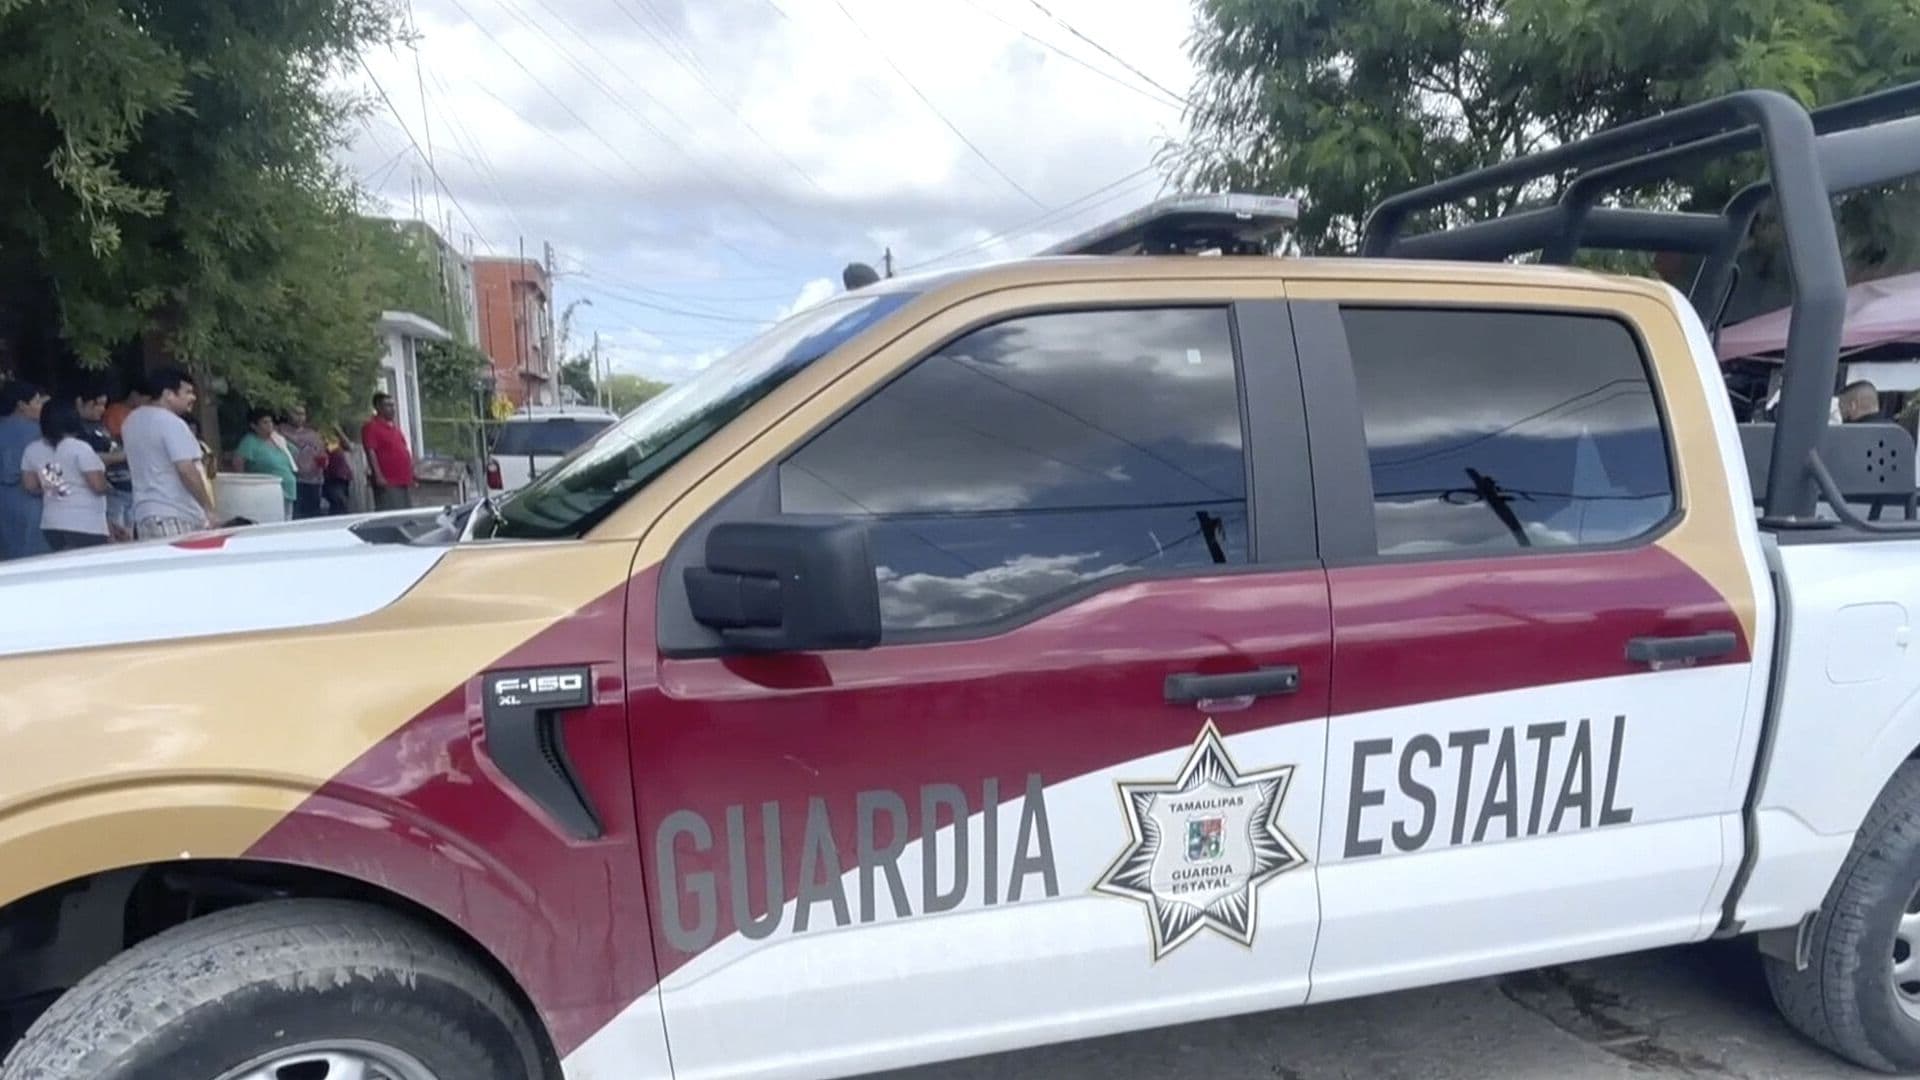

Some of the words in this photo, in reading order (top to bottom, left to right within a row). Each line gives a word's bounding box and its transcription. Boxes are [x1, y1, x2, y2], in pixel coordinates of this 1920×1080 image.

[495, 674, 582, 694] F-150
[499, 694, 521, 706] XL
[1169, 796, 1244, 813] TAMAULIPAS
[656, 773, 1060, 953] GUARDIA
[1344, 715, 1634, 859] ESTATAL
[1172, 864, 1233, 881] GUARDIA
[1172, 877, 1230, 895] ESTATAL
